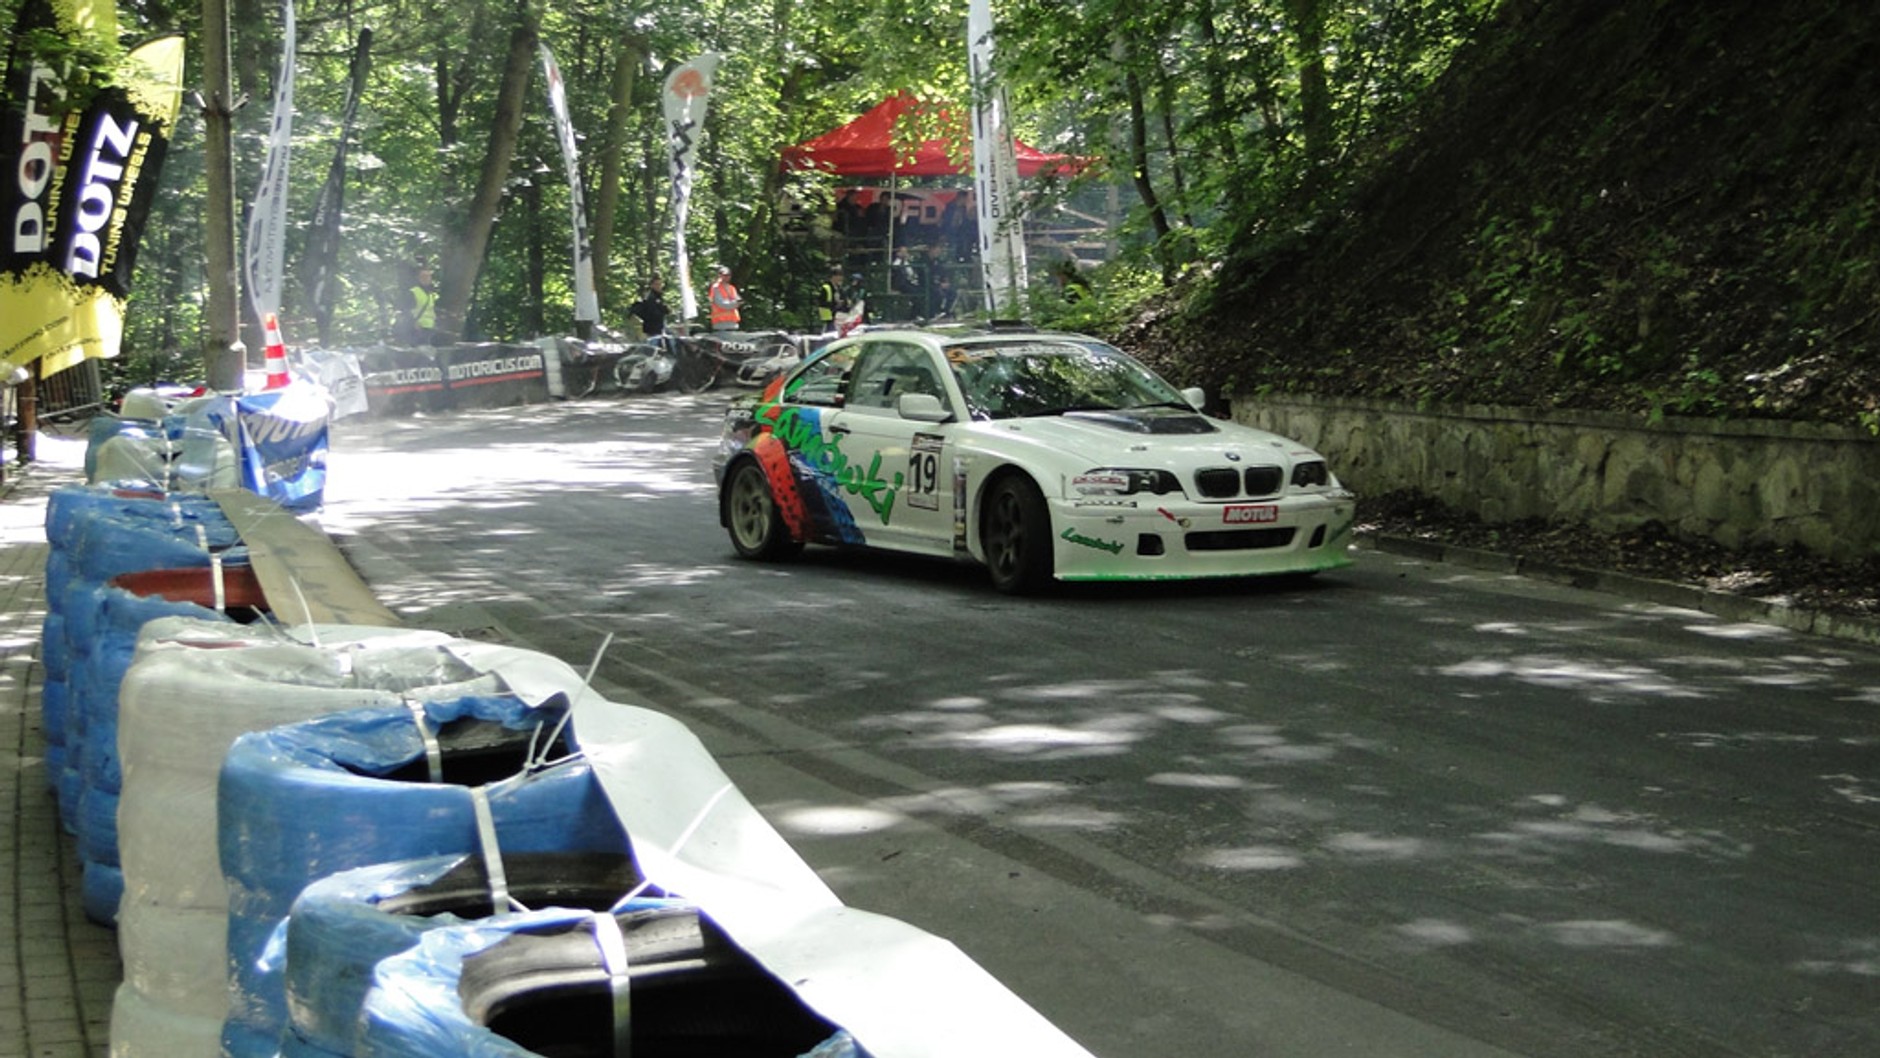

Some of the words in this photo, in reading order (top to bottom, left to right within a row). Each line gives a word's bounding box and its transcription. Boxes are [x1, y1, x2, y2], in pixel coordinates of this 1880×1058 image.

[45, 166, 67, 249] TUNING
[70, 112, 139, 279] DOTZ
[101, 207, 127, 275] TUNING
[116, 131, 153, 206] WHEELS
[909, 452, 936, 494] 19
[1225, 508, 1276, 521] MOTUL
